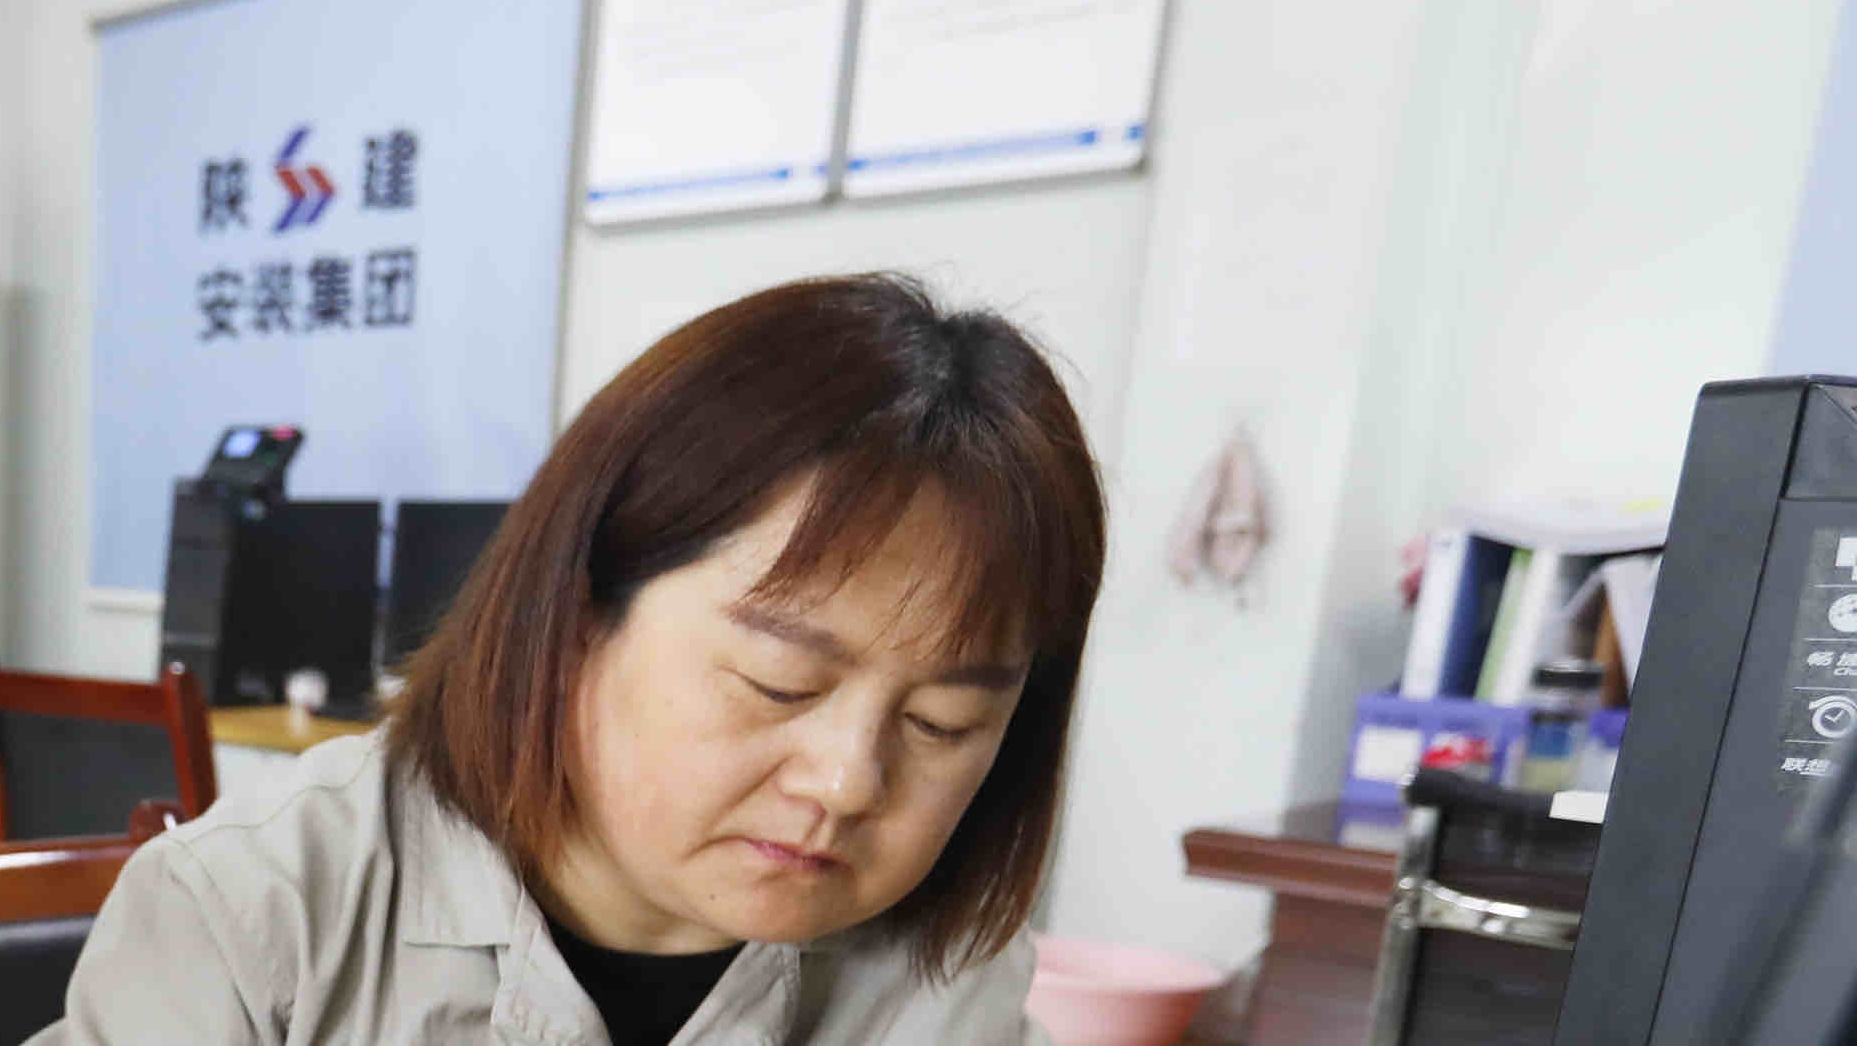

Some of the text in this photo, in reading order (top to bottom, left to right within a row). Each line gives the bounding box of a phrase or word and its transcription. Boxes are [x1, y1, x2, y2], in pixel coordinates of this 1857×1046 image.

[200, 129, 419, 231] 陕 建
[198, 246, 417, 341] 安装集团
